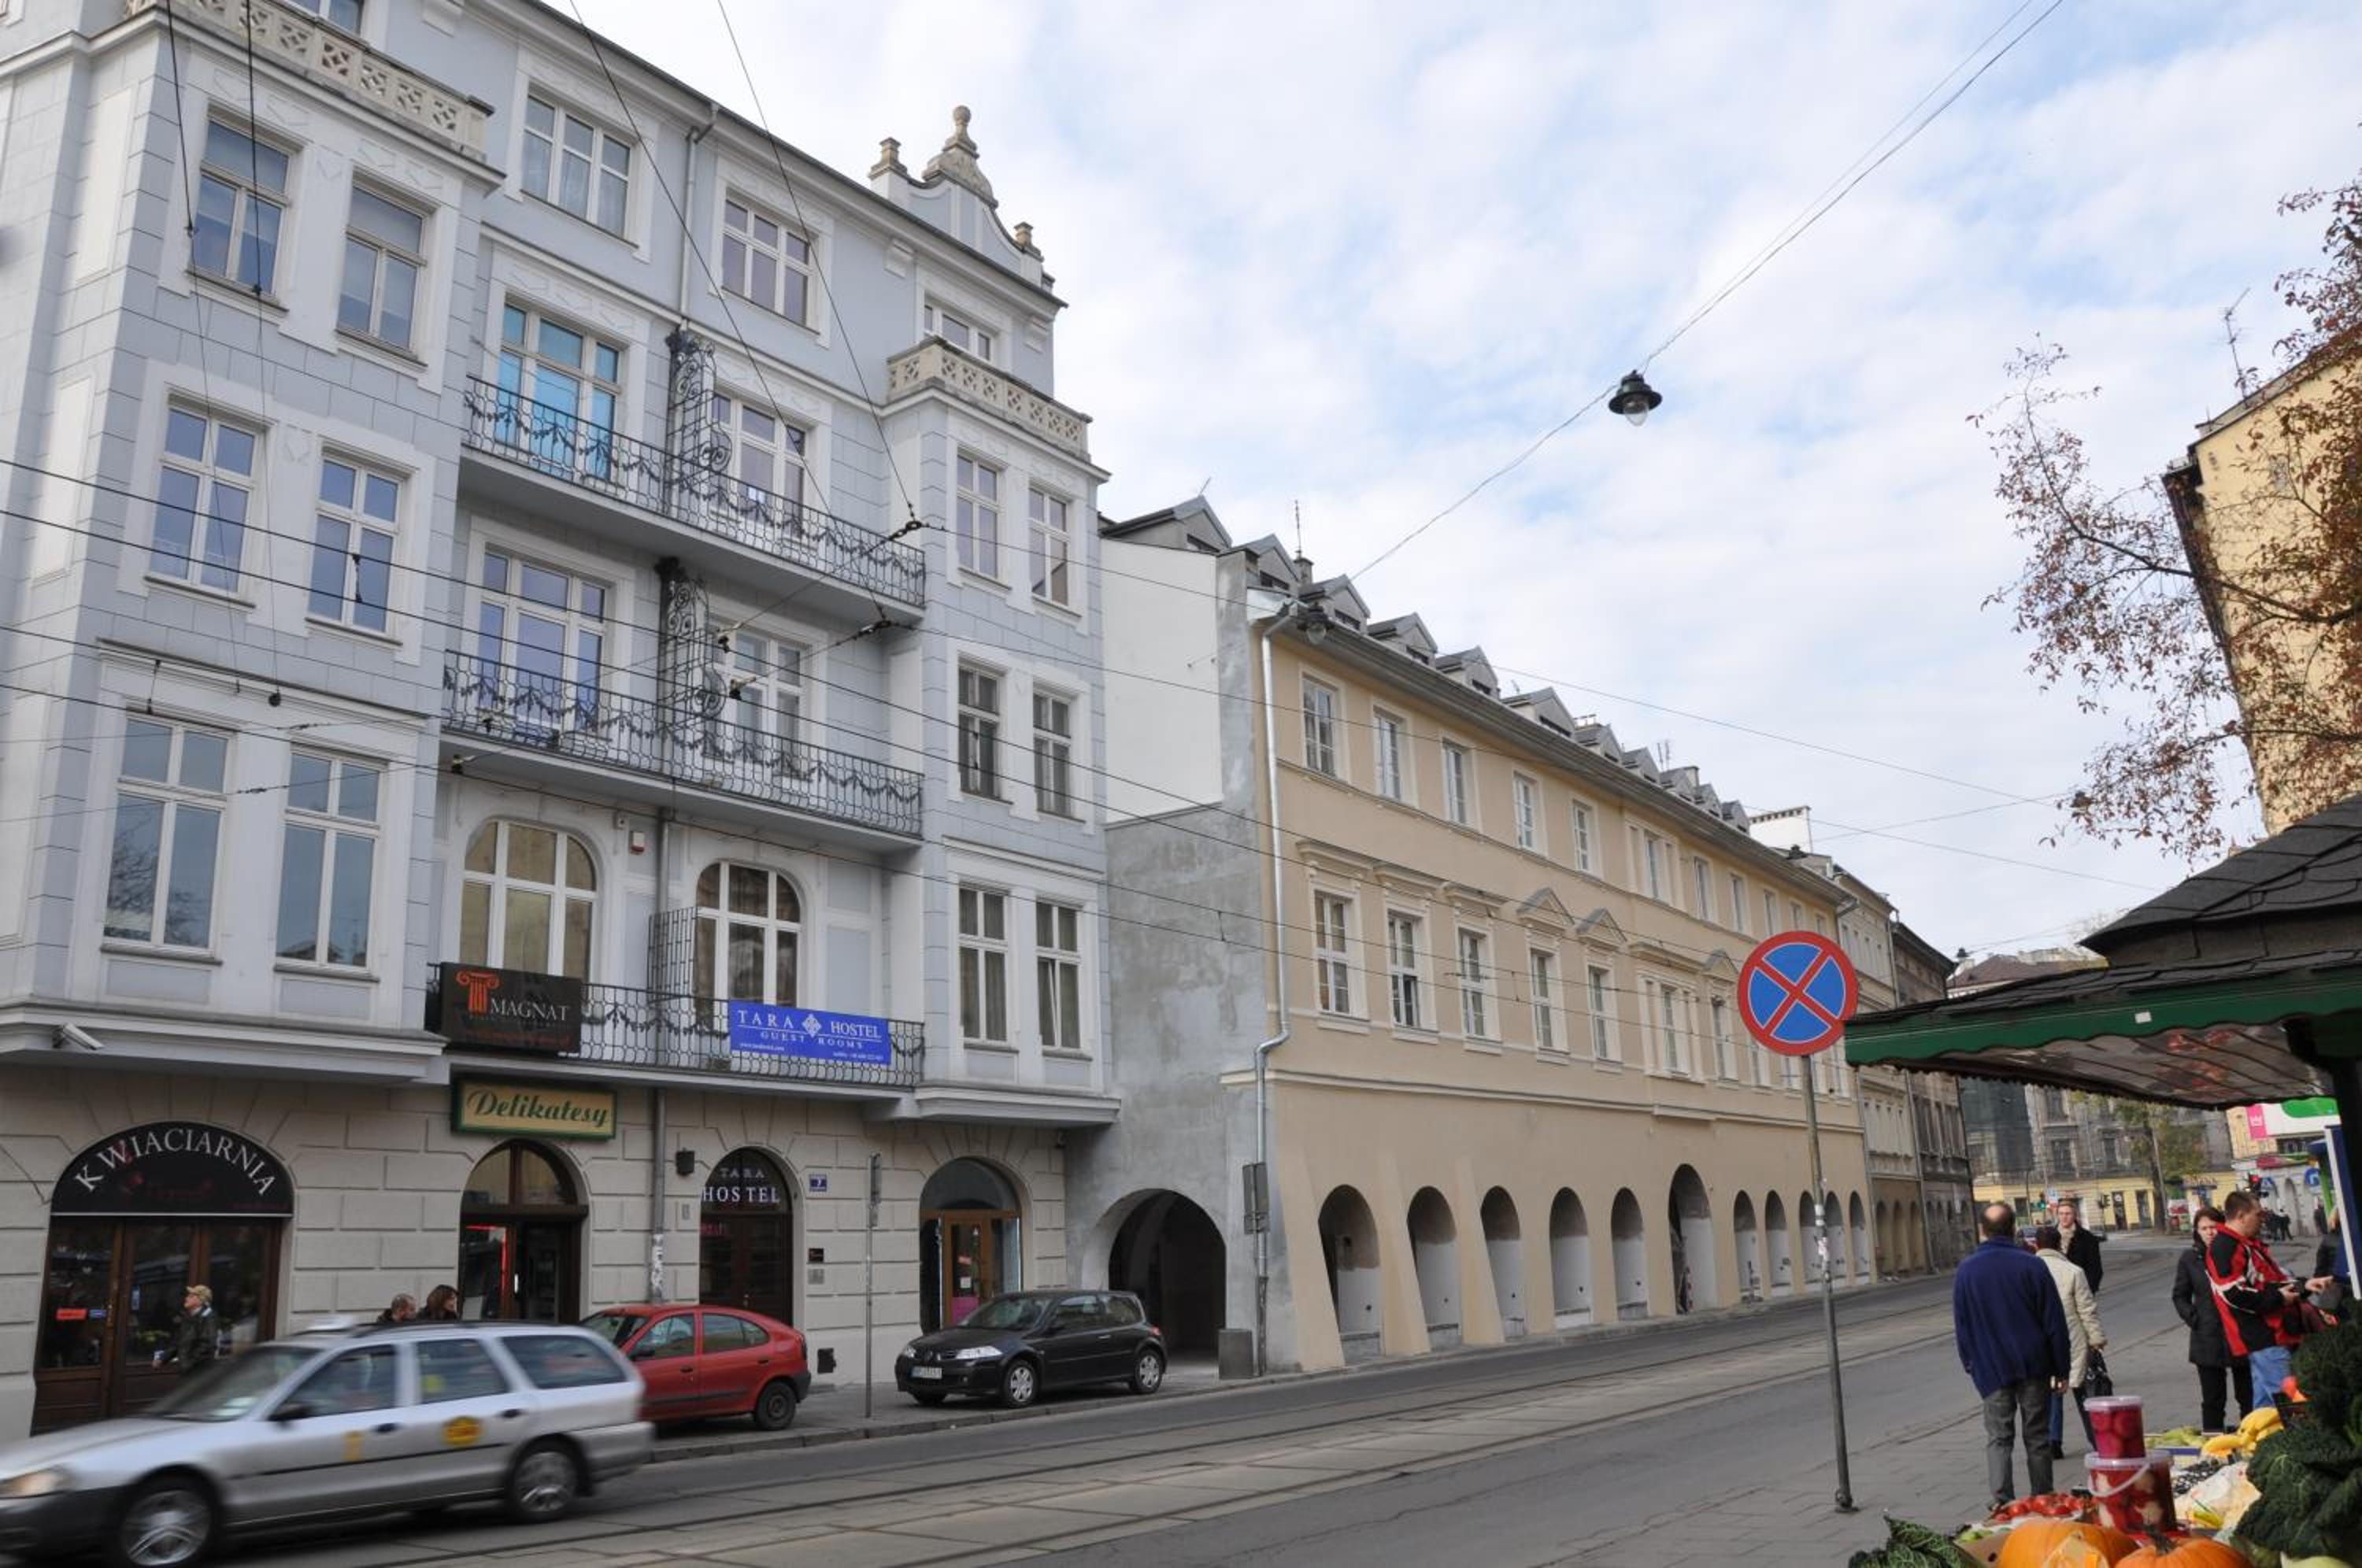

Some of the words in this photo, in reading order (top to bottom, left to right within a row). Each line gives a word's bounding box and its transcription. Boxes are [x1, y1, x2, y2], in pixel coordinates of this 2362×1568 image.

[490, 997, 568, 1021] MAGNAT
[737, 1010, 794, 1029] TARA
[830, 1021, 882, 1038] HOSTEL
[760, 1031, 805, 1042] GUEST
[817, 1037, 863, 1049] ROOMS
[466, 1089, 608, 1128] Delikatesy
[75, 1127, 276, 1196] KWIACIARNIA
[720, 1167, 765, 1178] TARA
